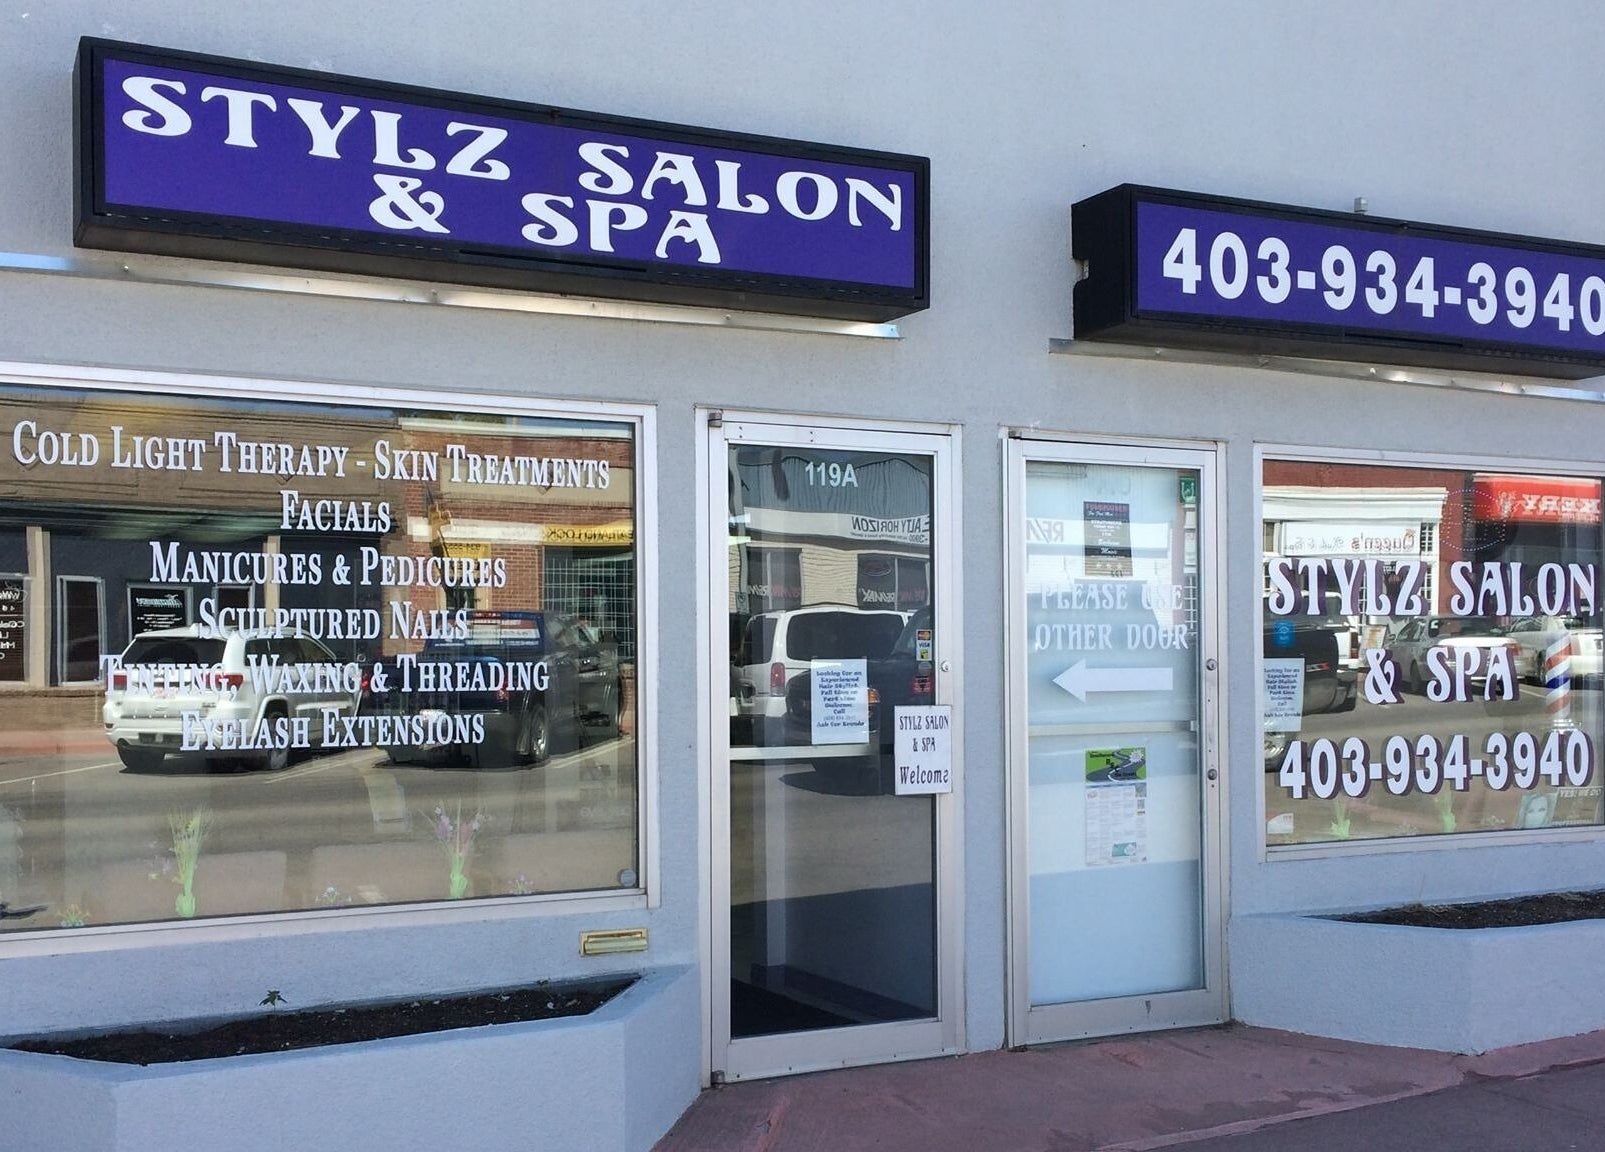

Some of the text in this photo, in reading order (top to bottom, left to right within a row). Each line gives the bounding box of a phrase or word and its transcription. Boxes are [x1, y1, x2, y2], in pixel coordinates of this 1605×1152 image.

[122, 76, 902, 231] STYLZ SALON
[369, 173, 721, 264] & SPA
[1163, 227, 1605, 337] 403-934-3940
[12, 419, 99, 467] COLD
[112, 425, 206, 472] LIGHT
[214, 430, 347, 478] THERAPY
[374, 440, 438, 482] SKIN
[446, 444, 611, 490] TREATMENTS
[805, 462, 859, 488] 119A
[280, 489, 392, 535] FACIALS
[149, 540, 507, 589] MANICURES & PEDICURES
[1268, 558, 1597, 616] STYLZ SALON
[198, 597, 379, 641] SCULPTURED
[389, 601, 469, 641] NAILS
[1040, 582, 1128, 610] PLEASE
[1036, 622, 1190, 651] OTHER DOOR
[99, 654, 549, 700] TINTING, WAXING & THREADING
[1364, 646, 1520, 704] & SPA
[180, 707, 486, 752] EYELASH EXTENSIONS
[899, 715, 949, 730] STYLZ SALON
[912, 737, 936, 752] & SPA
[1280, 730, 1594, 799] 403-934-3940
